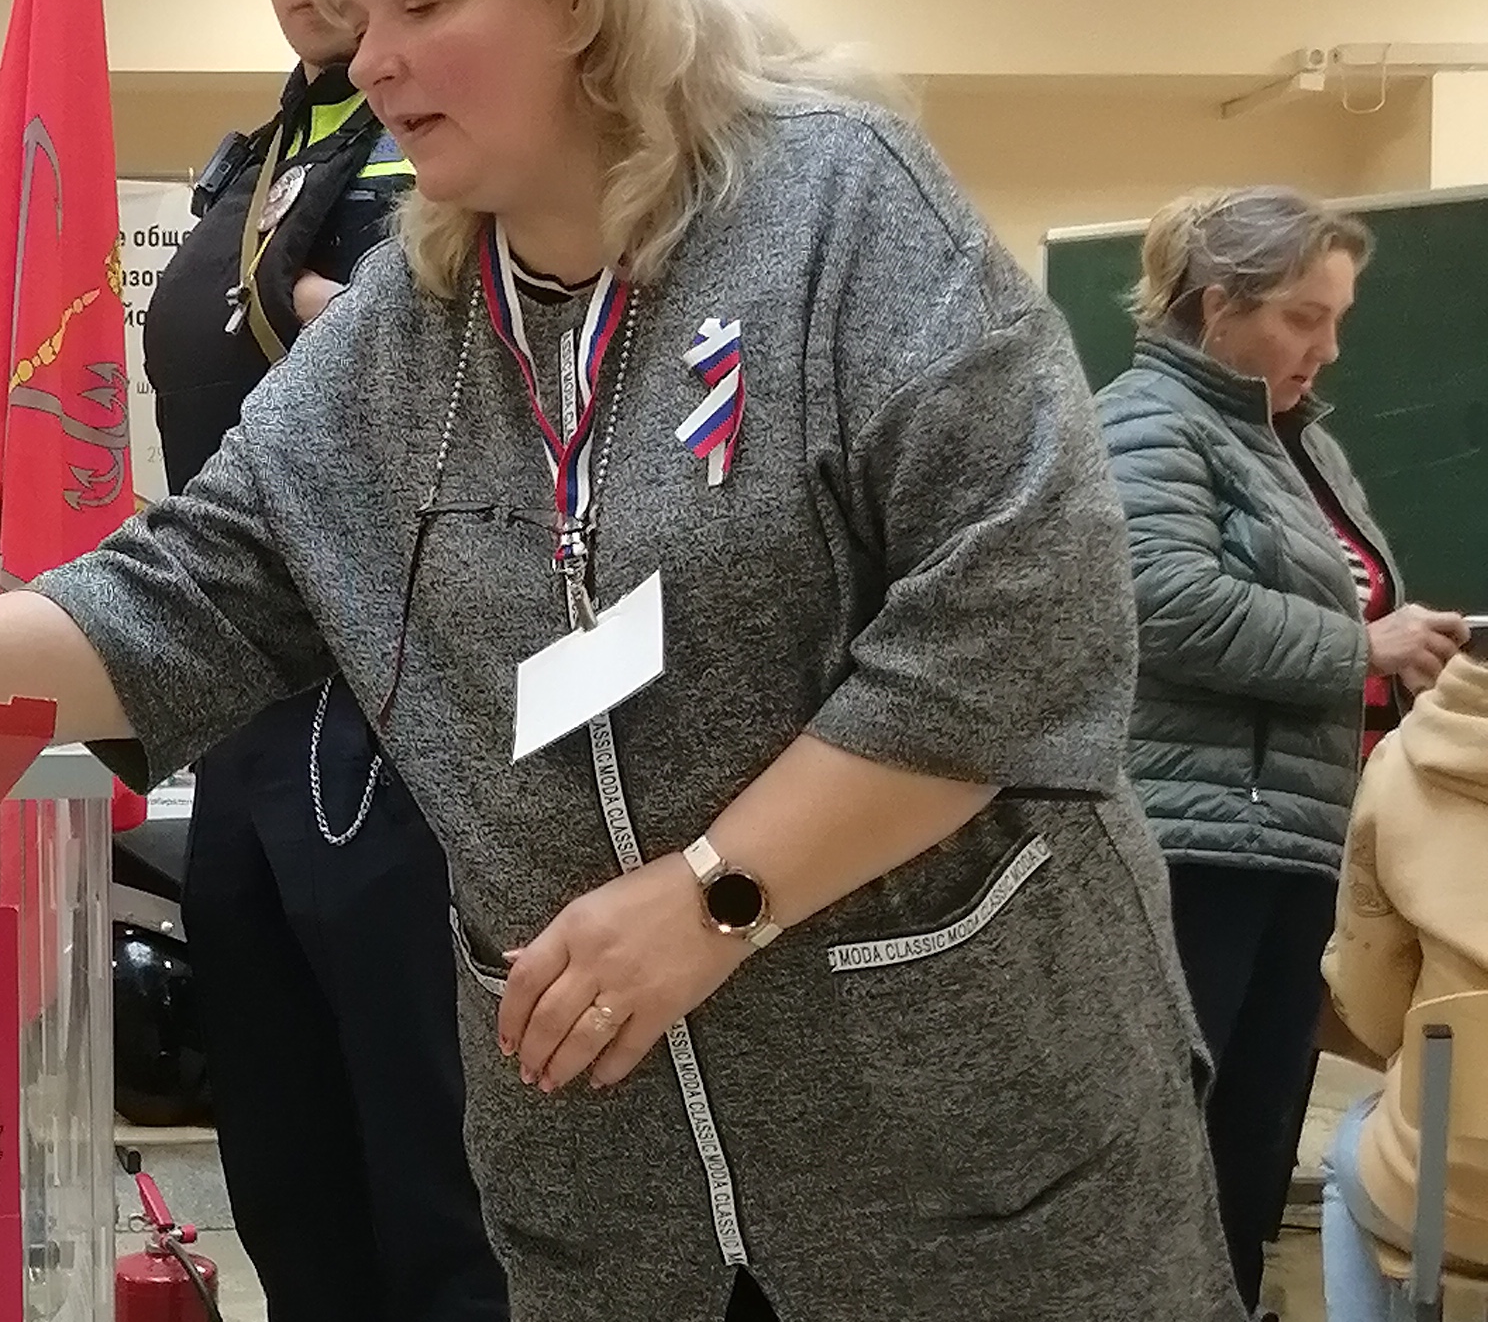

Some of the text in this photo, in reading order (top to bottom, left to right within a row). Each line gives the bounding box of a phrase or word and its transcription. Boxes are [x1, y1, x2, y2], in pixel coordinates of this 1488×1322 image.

[599, 765, 621, 806] MODA
[607, 807, 639, 865] CLASSIC
[839, 946, 883, 967] MODA
[885, 933, 945, 961] CLASSIC
